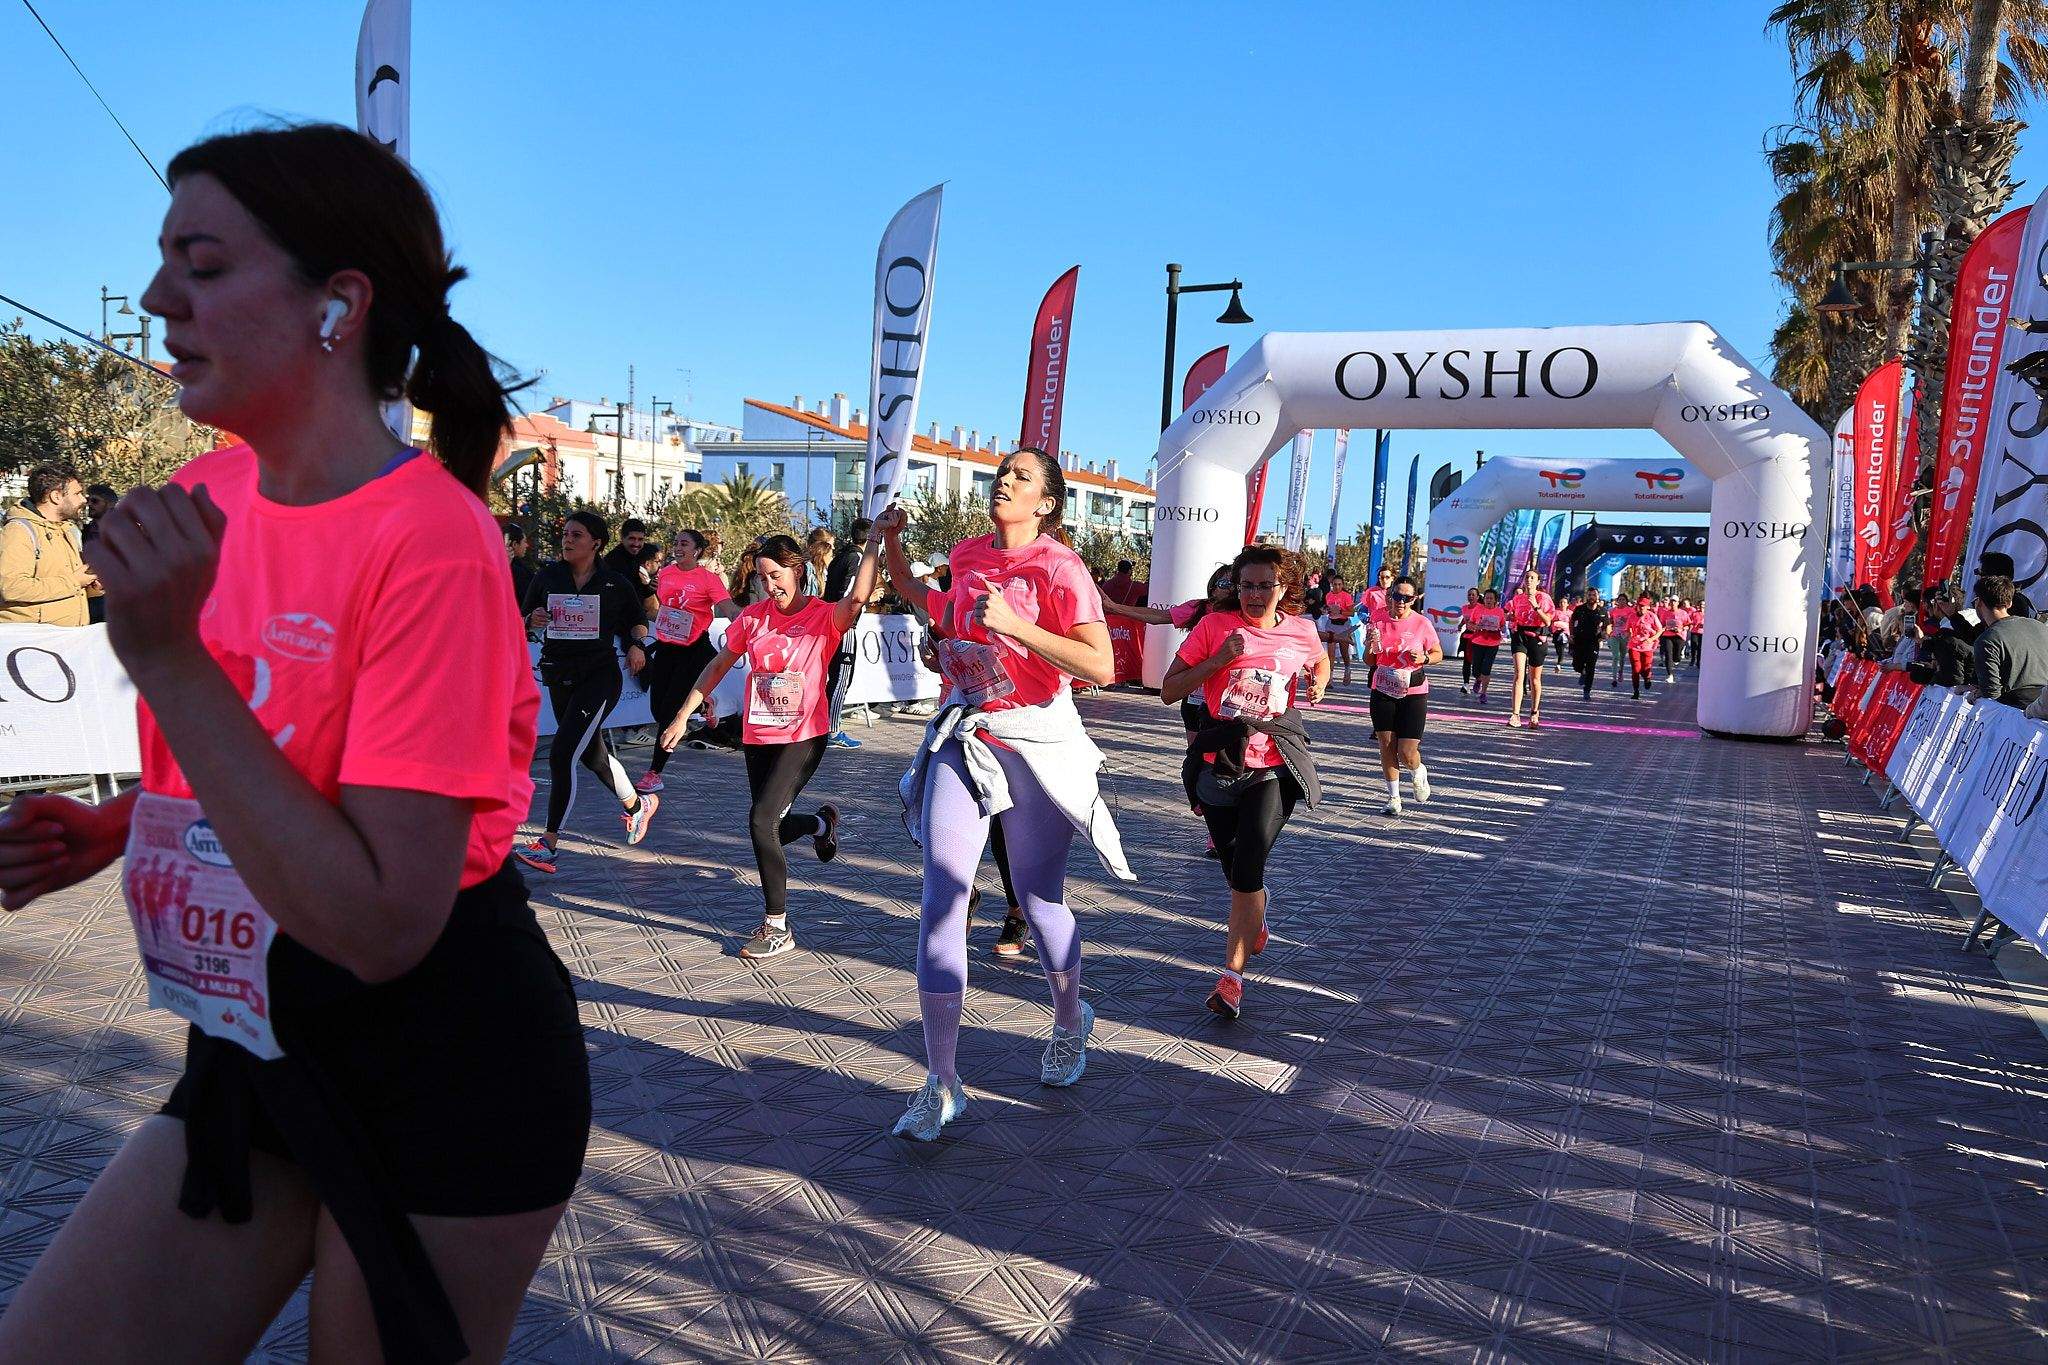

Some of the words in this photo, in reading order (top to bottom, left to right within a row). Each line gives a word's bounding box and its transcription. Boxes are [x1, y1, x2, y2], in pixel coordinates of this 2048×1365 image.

[1335, 347, 1599, 400] OYSHO
[1193, 409, 1261, 425] OYSHO
[1681, 404, 1770, 422] OYSHO
[1864, 400, 1886, 517] Santander
[1538, 491, 1586, 500] TotalEnergies
[1634, 493, 1684, 501] TotalEnergies
[1157, 506, 1219, 522] OYSHO
[1724, 521, 1807, 540] OYSHO
[1612, 535, 1707, 545] VOLVO
[564, 614, 584, 623] 016
[1716, 634, 1799, 653] OYSHO
[769, 696, 789, 705] 016
[1245, 692, 1268, 706] 016
[181, 904, 256, 949] 016
[194, 954, 231, 974] 3196
